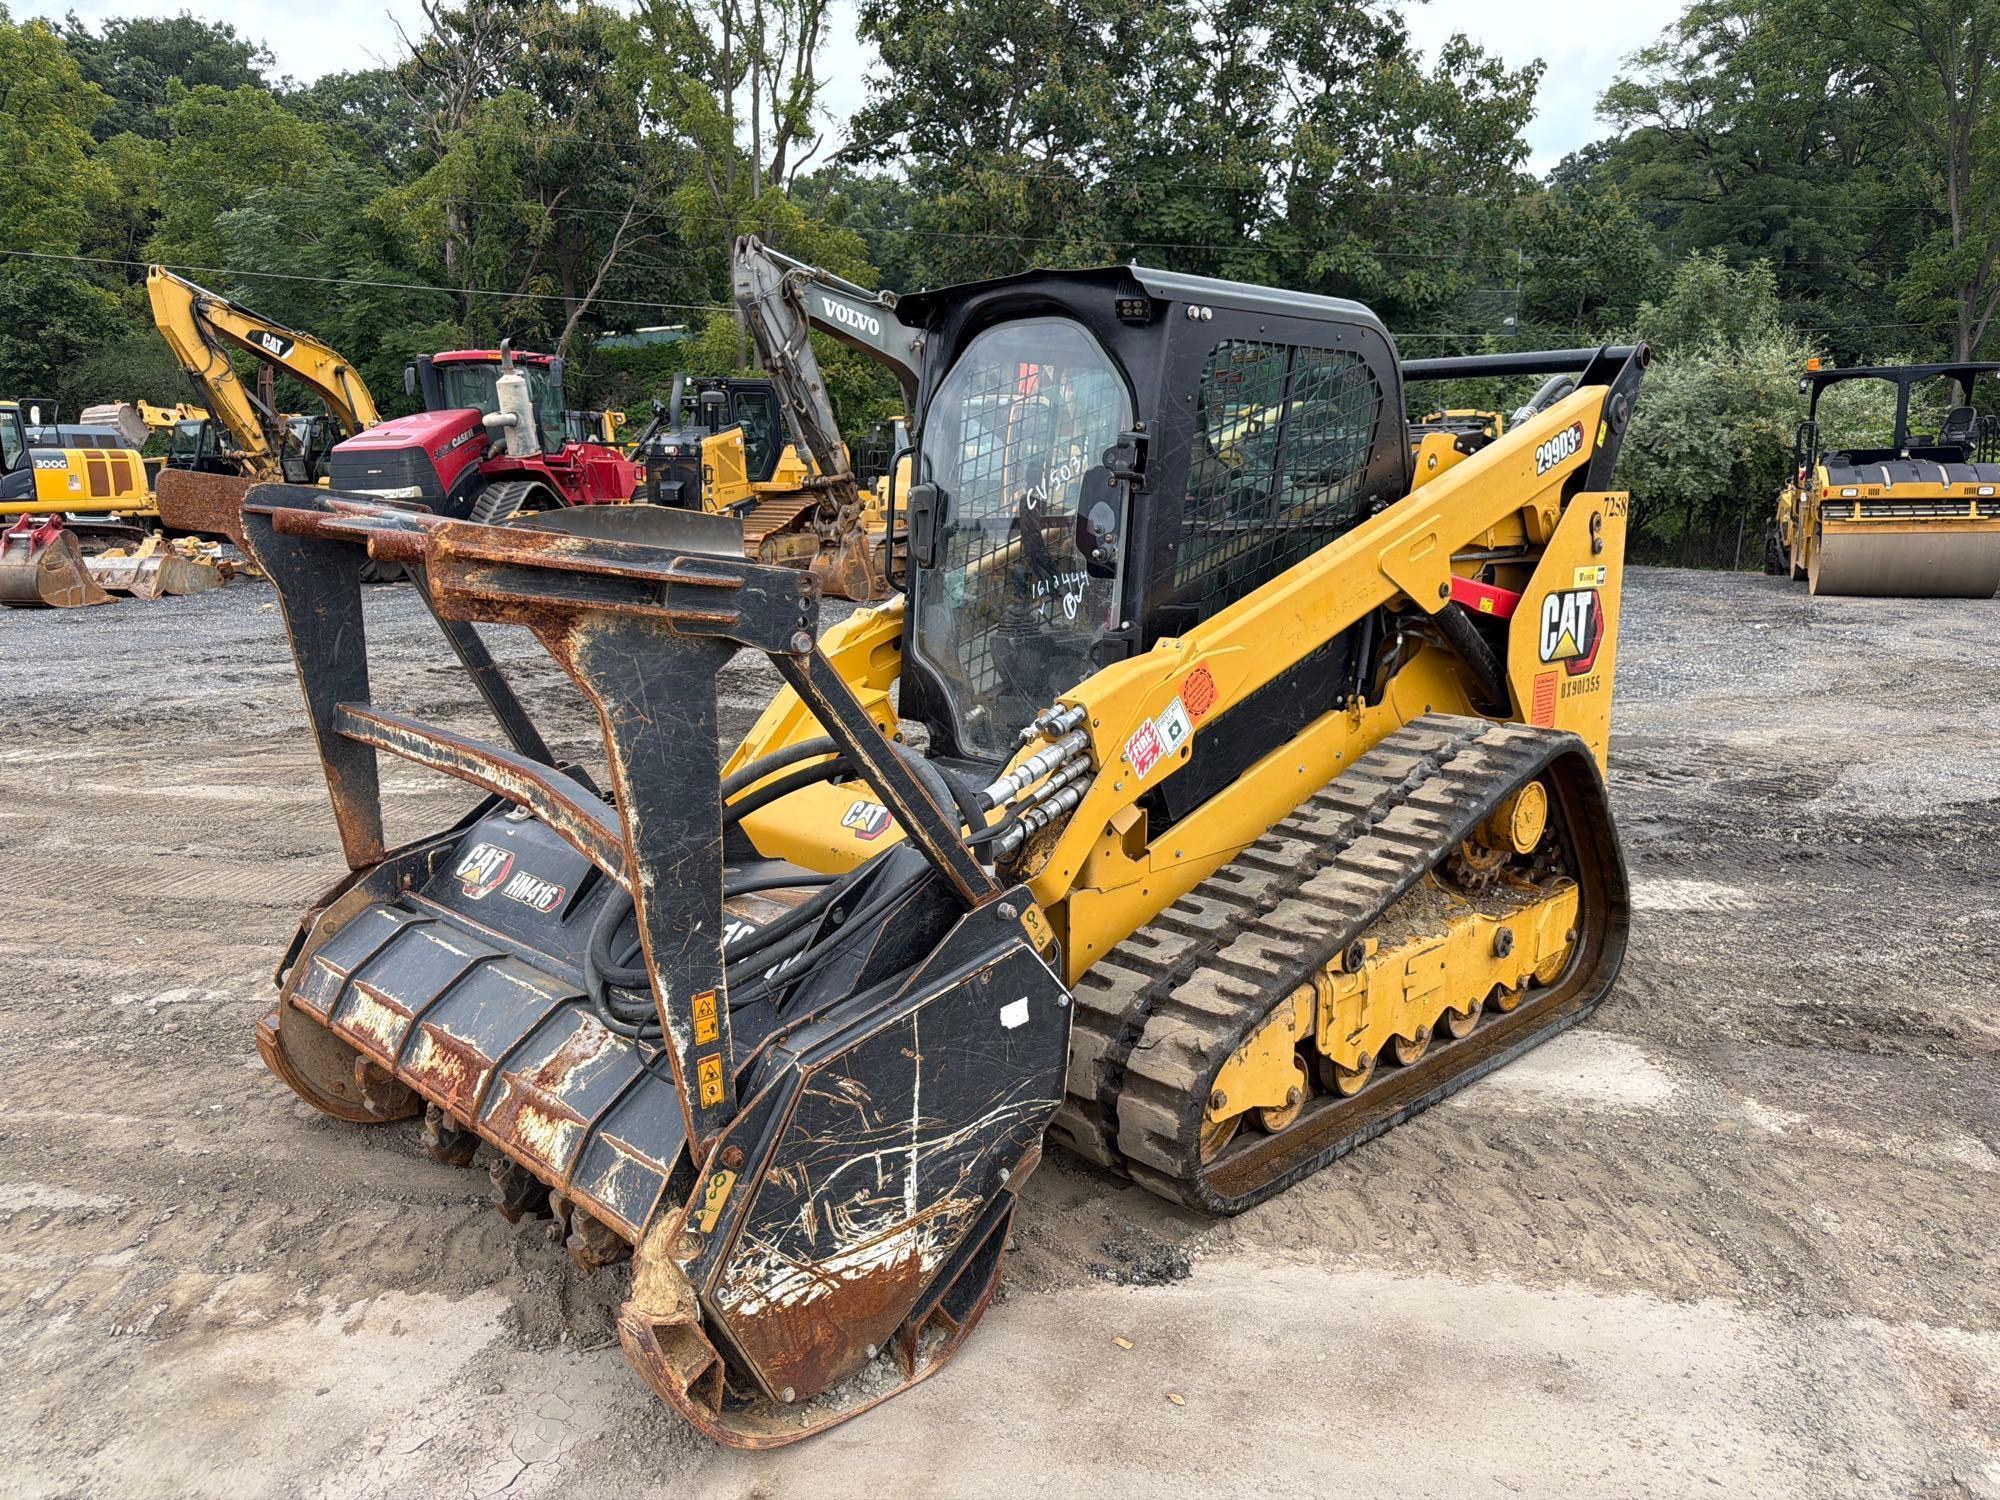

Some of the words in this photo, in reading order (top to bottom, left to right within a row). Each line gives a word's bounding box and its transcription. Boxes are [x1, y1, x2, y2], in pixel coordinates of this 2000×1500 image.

[822, 297, 880, 335] VOLVO
[263, 333, 284, 355] CAT
[35, 460, 67, 469] 300G
[1536, 426, 1576, 474] 299D3
[1603, 496, 1628, 518] 7258
[1540, 591, 1592, 662] CAT
[1561, 676, 1601, 699] BX901355
[1131, 730, 1155, 758] FIRE
[842, 800, 888, 832] CAT
[456, 843, 510, 885] CAT
[504, 872, 558, 908] HM416
